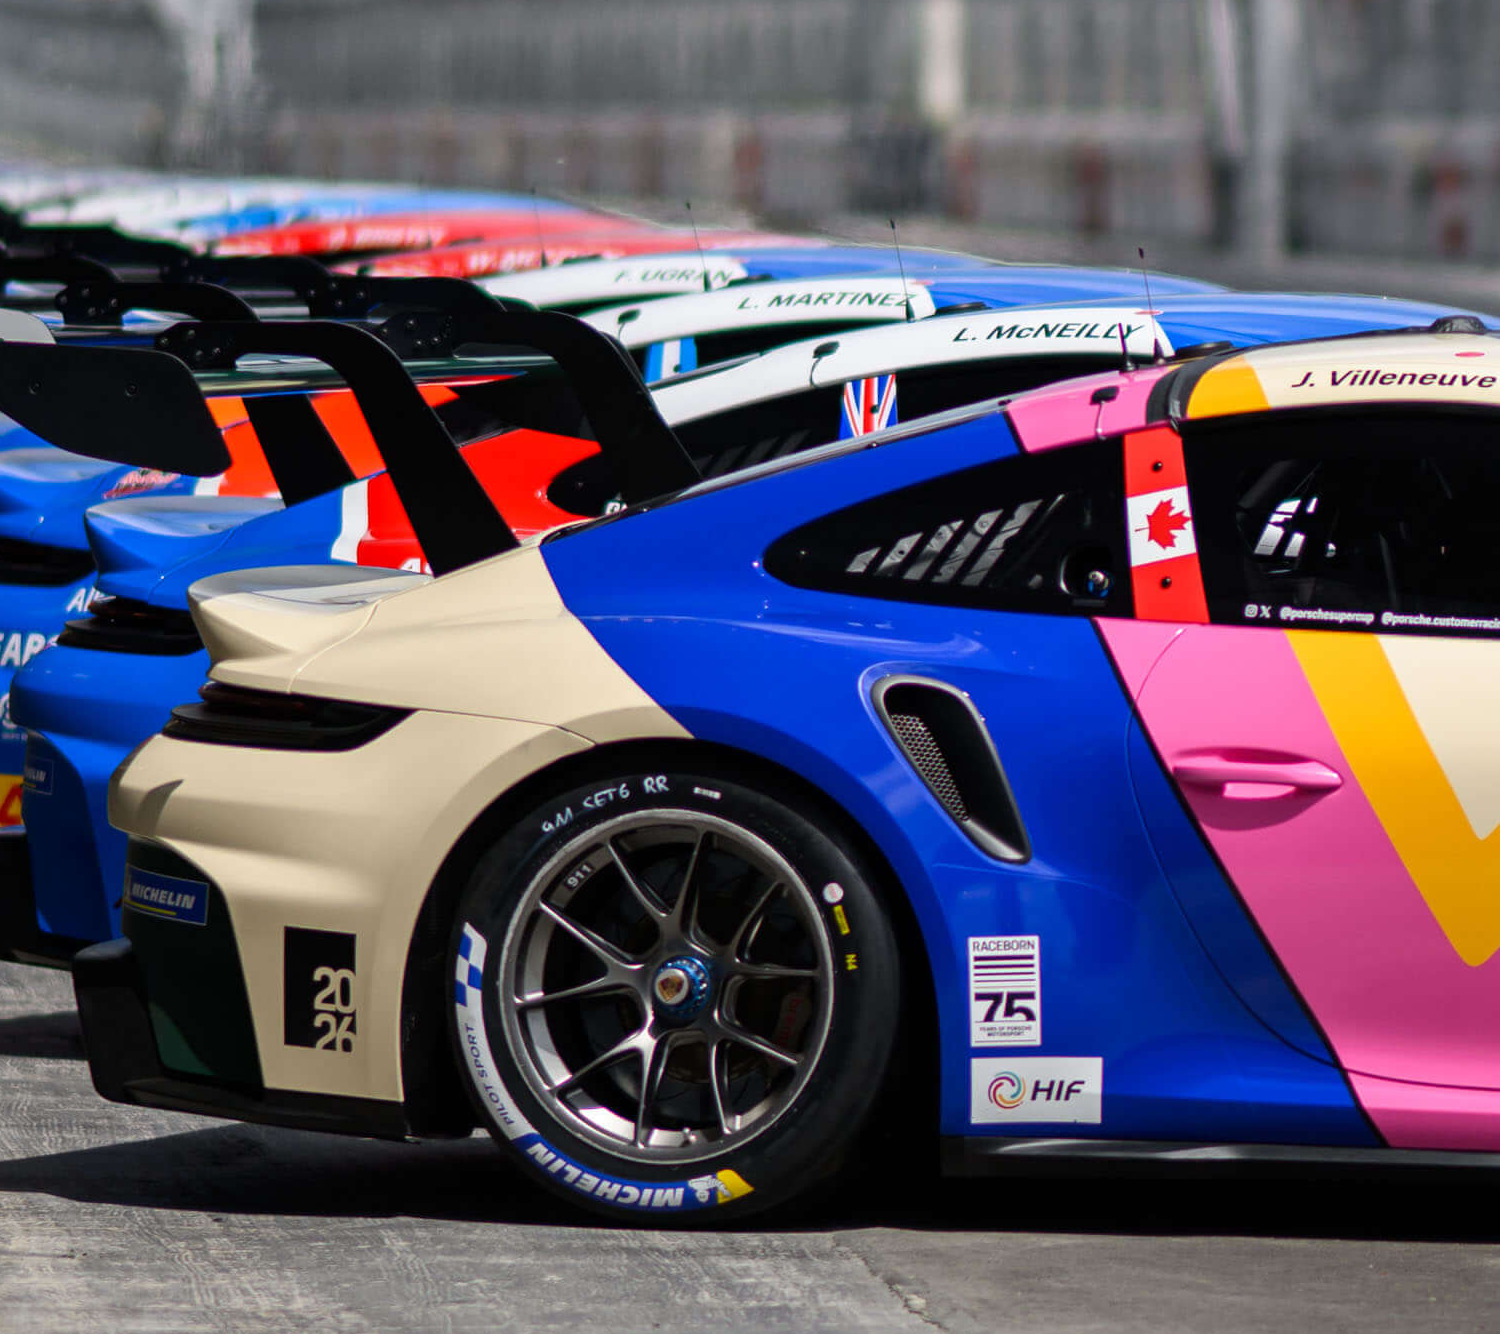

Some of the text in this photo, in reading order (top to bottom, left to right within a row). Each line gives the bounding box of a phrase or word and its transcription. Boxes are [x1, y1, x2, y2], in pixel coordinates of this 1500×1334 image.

[614, 268, 733, 283] F. UGRAN
[737, 291, 917, 310] L. MARTINEZ
[953, 322, 1145, 342] L. McNEILLY
[1291, 369, 1497, 388] J. Villeneuve
[643, 774, 670, 794] RR
[131, 882, 197, 910] MICHELIN
[972, 939, 1036, 952] RACEBORN
[312, 966, 357, 1014] 20
[974, 991, 1036, 1022] 75
[312, 1012, 357, 1053] 26
[1030, 1080, 1085, 1101] HIF
[464, 1022, 684, 1207] MICHELIN PILOT SPORT
